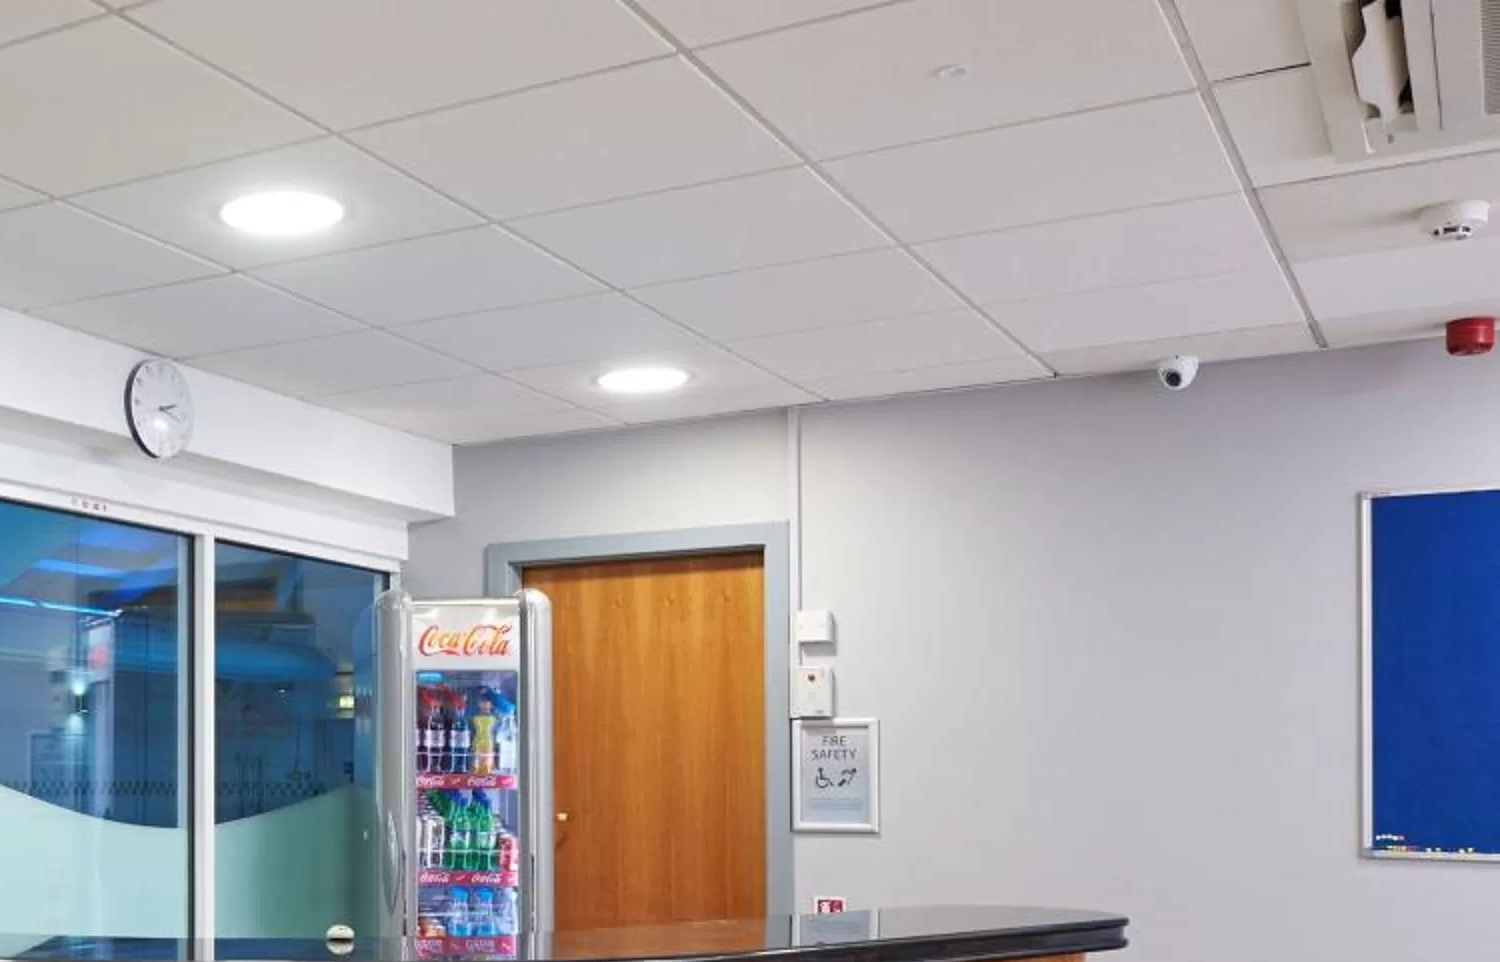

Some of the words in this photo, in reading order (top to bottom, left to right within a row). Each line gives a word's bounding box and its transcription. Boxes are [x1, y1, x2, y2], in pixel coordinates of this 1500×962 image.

[418, 624, 512, 656] Coca-Cola
[821, 735, 847, 747] FIRE
[812, 749, 857, 760] SAFETY
